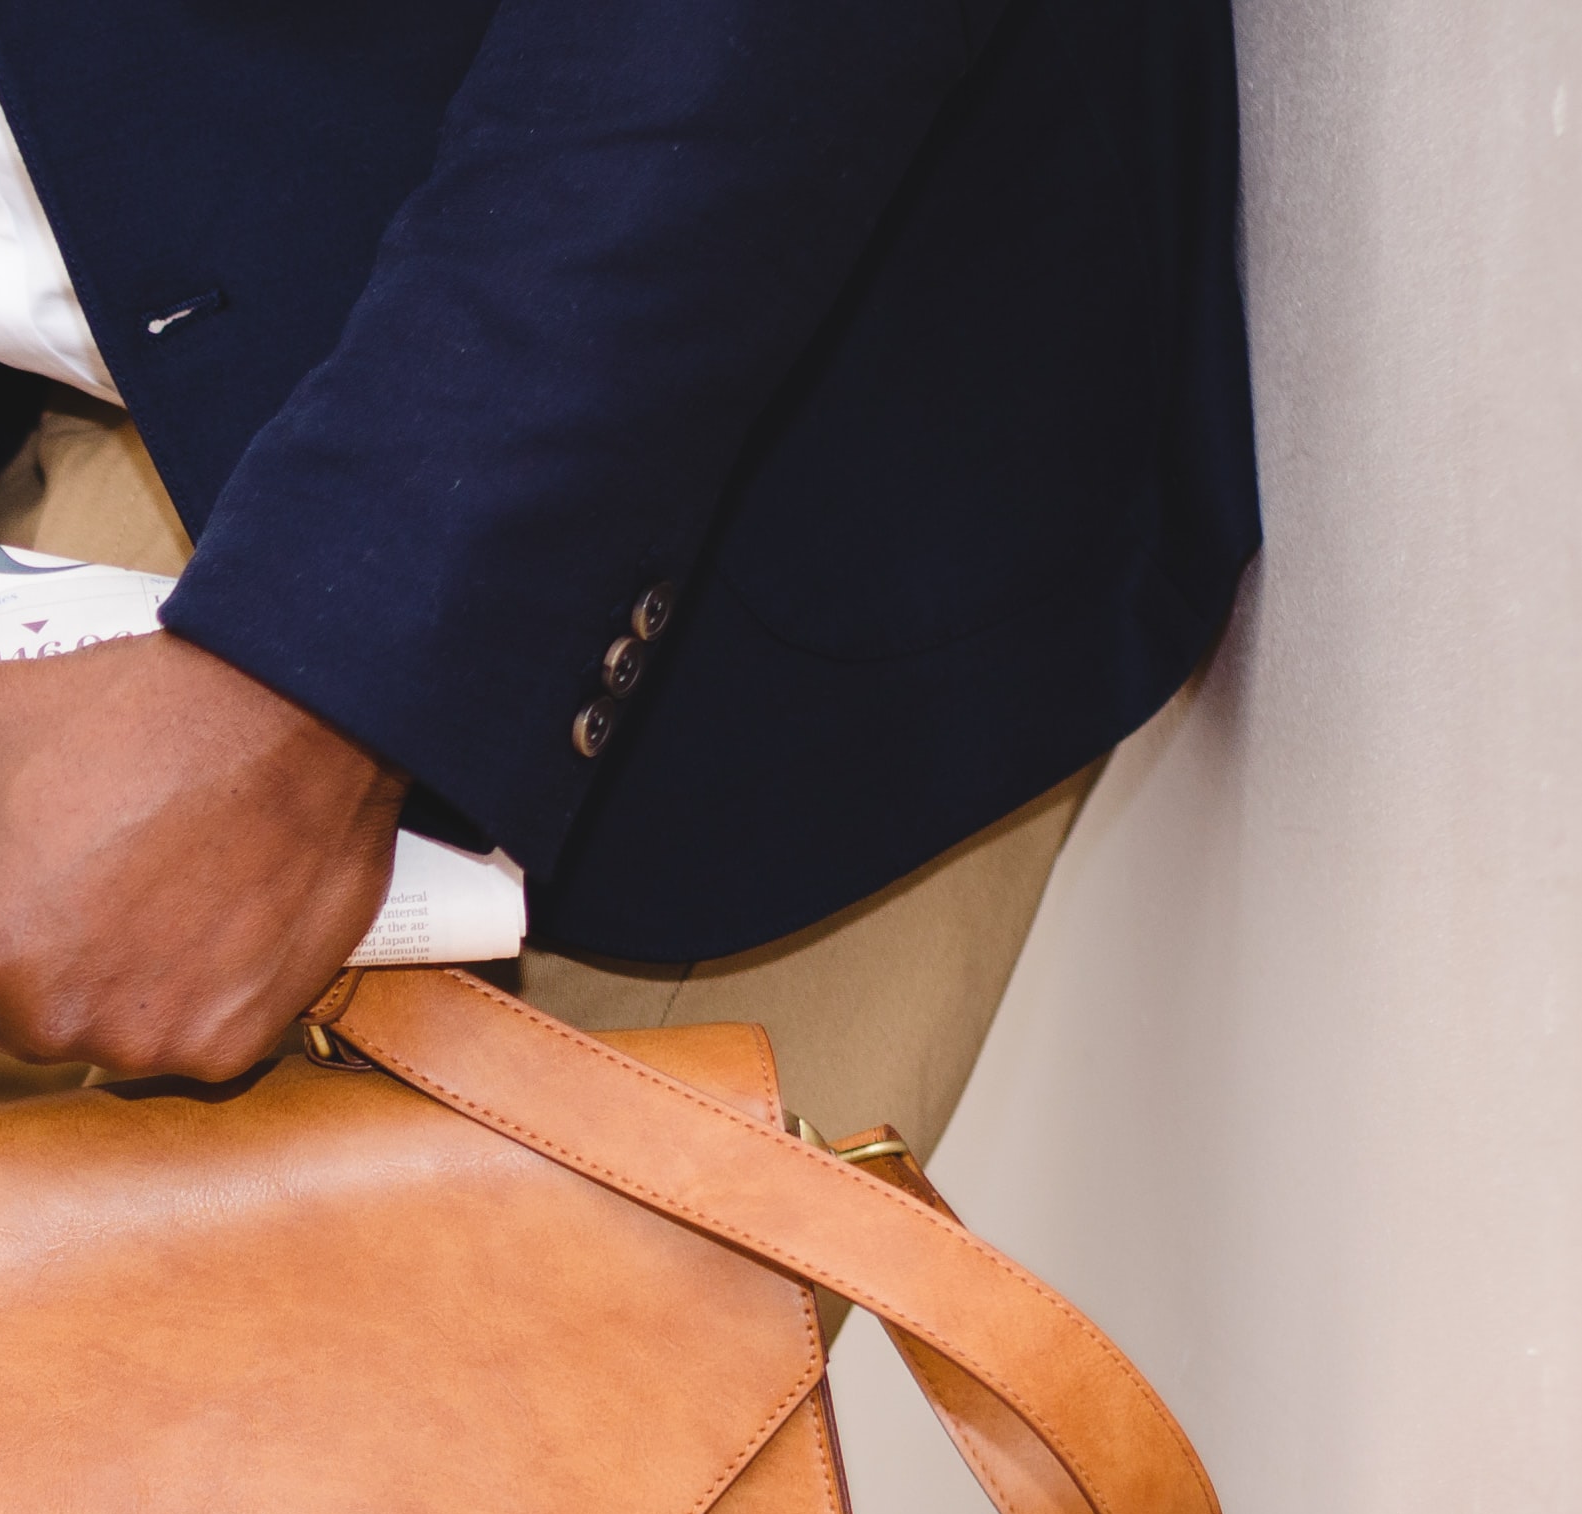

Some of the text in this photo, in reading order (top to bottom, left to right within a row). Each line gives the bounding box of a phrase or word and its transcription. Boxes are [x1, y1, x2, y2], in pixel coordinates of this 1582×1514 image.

[388, 890, 429, 904] ederal
[383, 906, 430, 919] interest
[388, 921, 407, 933] the
[380, 934, 430, 947] Japan to
[378, 945, 430, 956] stimulus
